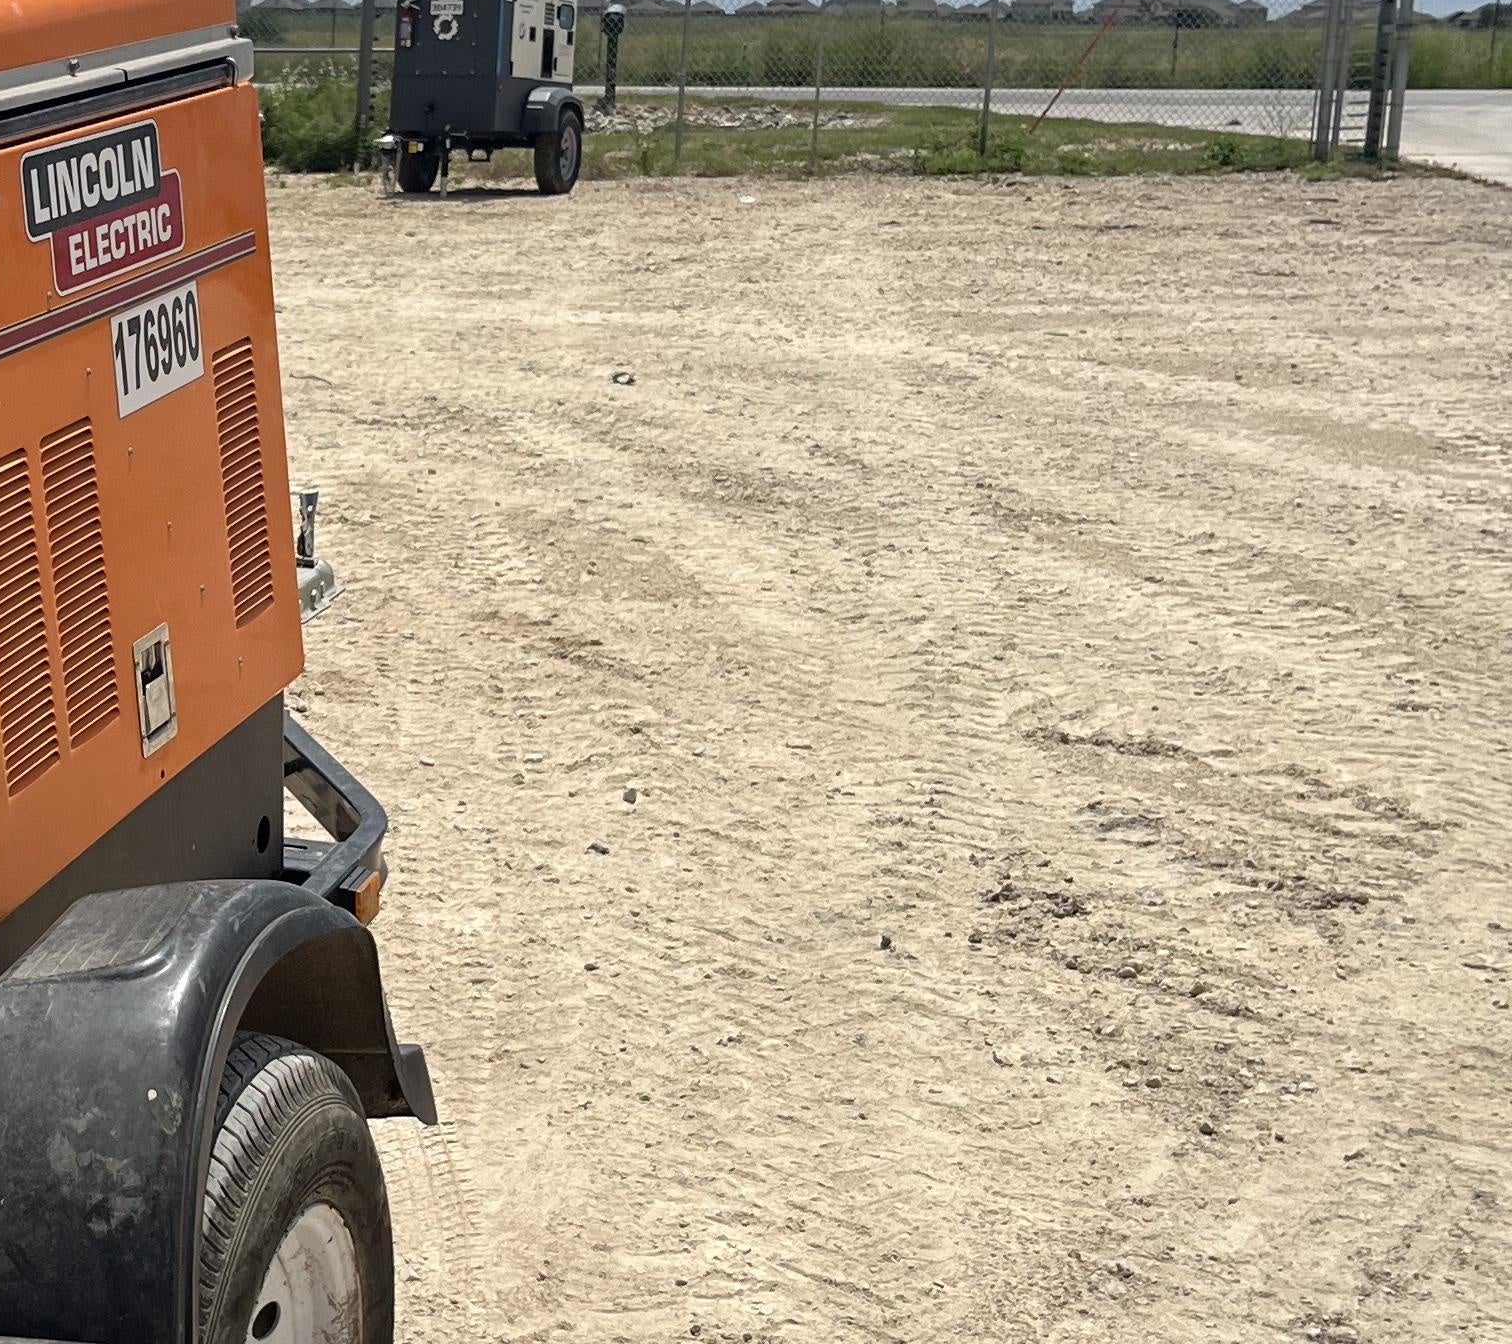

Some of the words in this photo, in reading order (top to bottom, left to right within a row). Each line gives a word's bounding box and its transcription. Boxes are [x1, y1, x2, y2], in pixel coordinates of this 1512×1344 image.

[31, 135, 155, 224] LINCOLN
[69, 203, 172, 276] ELECTRIC
[114, 289, 201, 396] 176960
